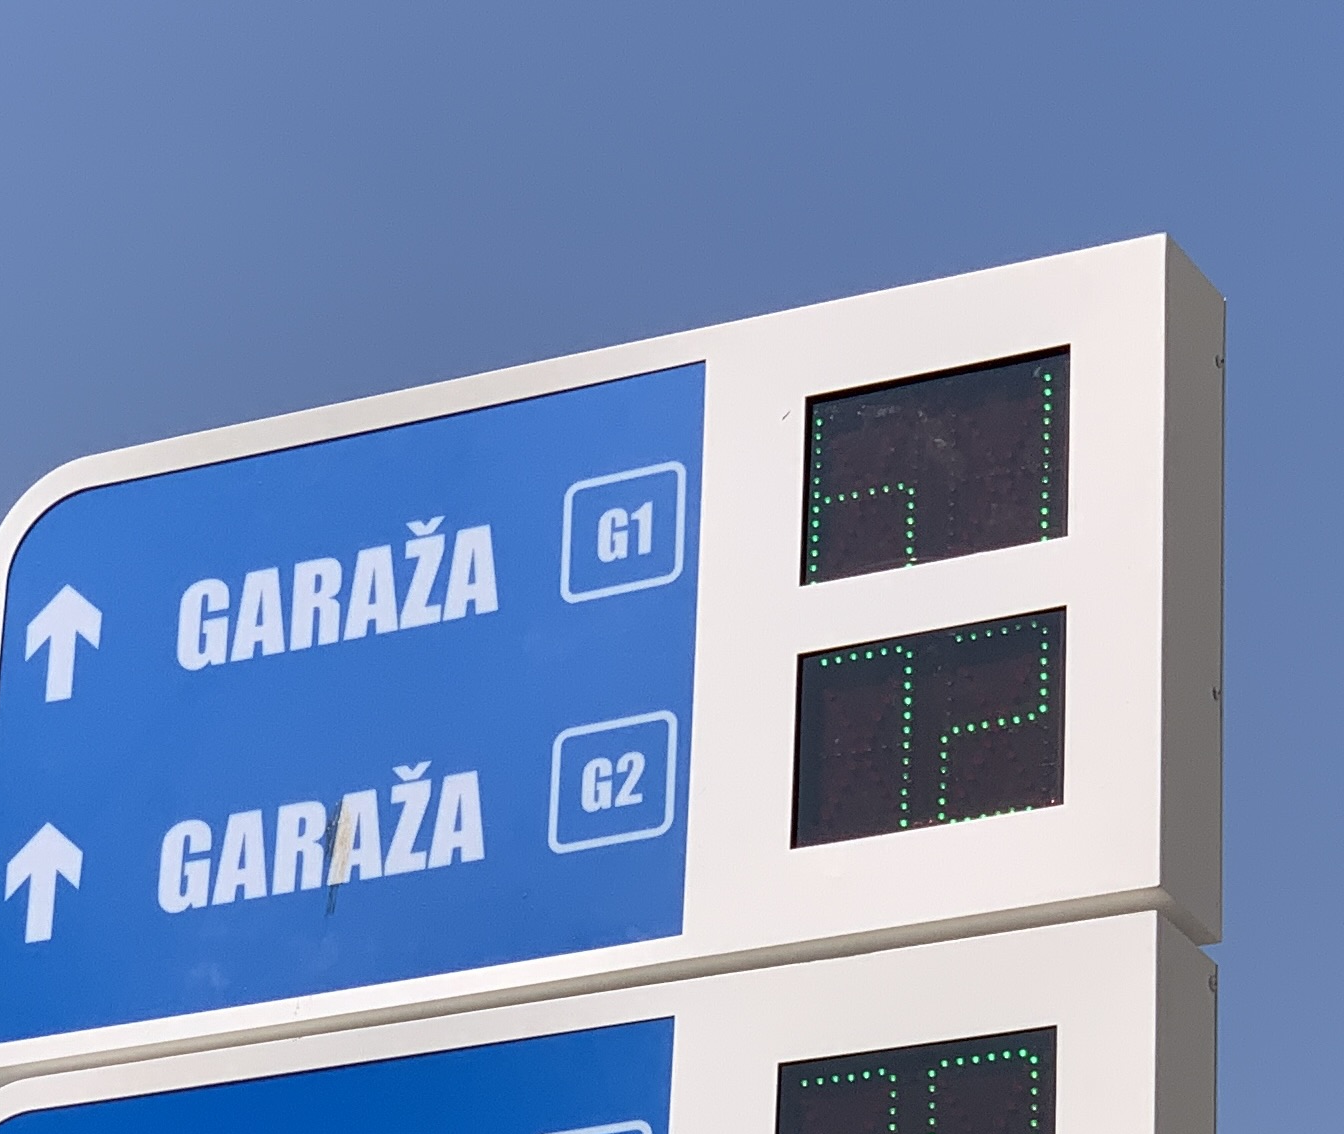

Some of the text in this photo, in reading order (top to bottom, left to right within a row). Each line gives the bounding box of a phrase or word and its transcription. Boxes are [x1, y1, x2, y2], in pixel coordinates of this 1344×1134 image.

[176, 501, 654, 671] GARAŽA G1
[157, 750, 647, 914] GARAŽA G2
